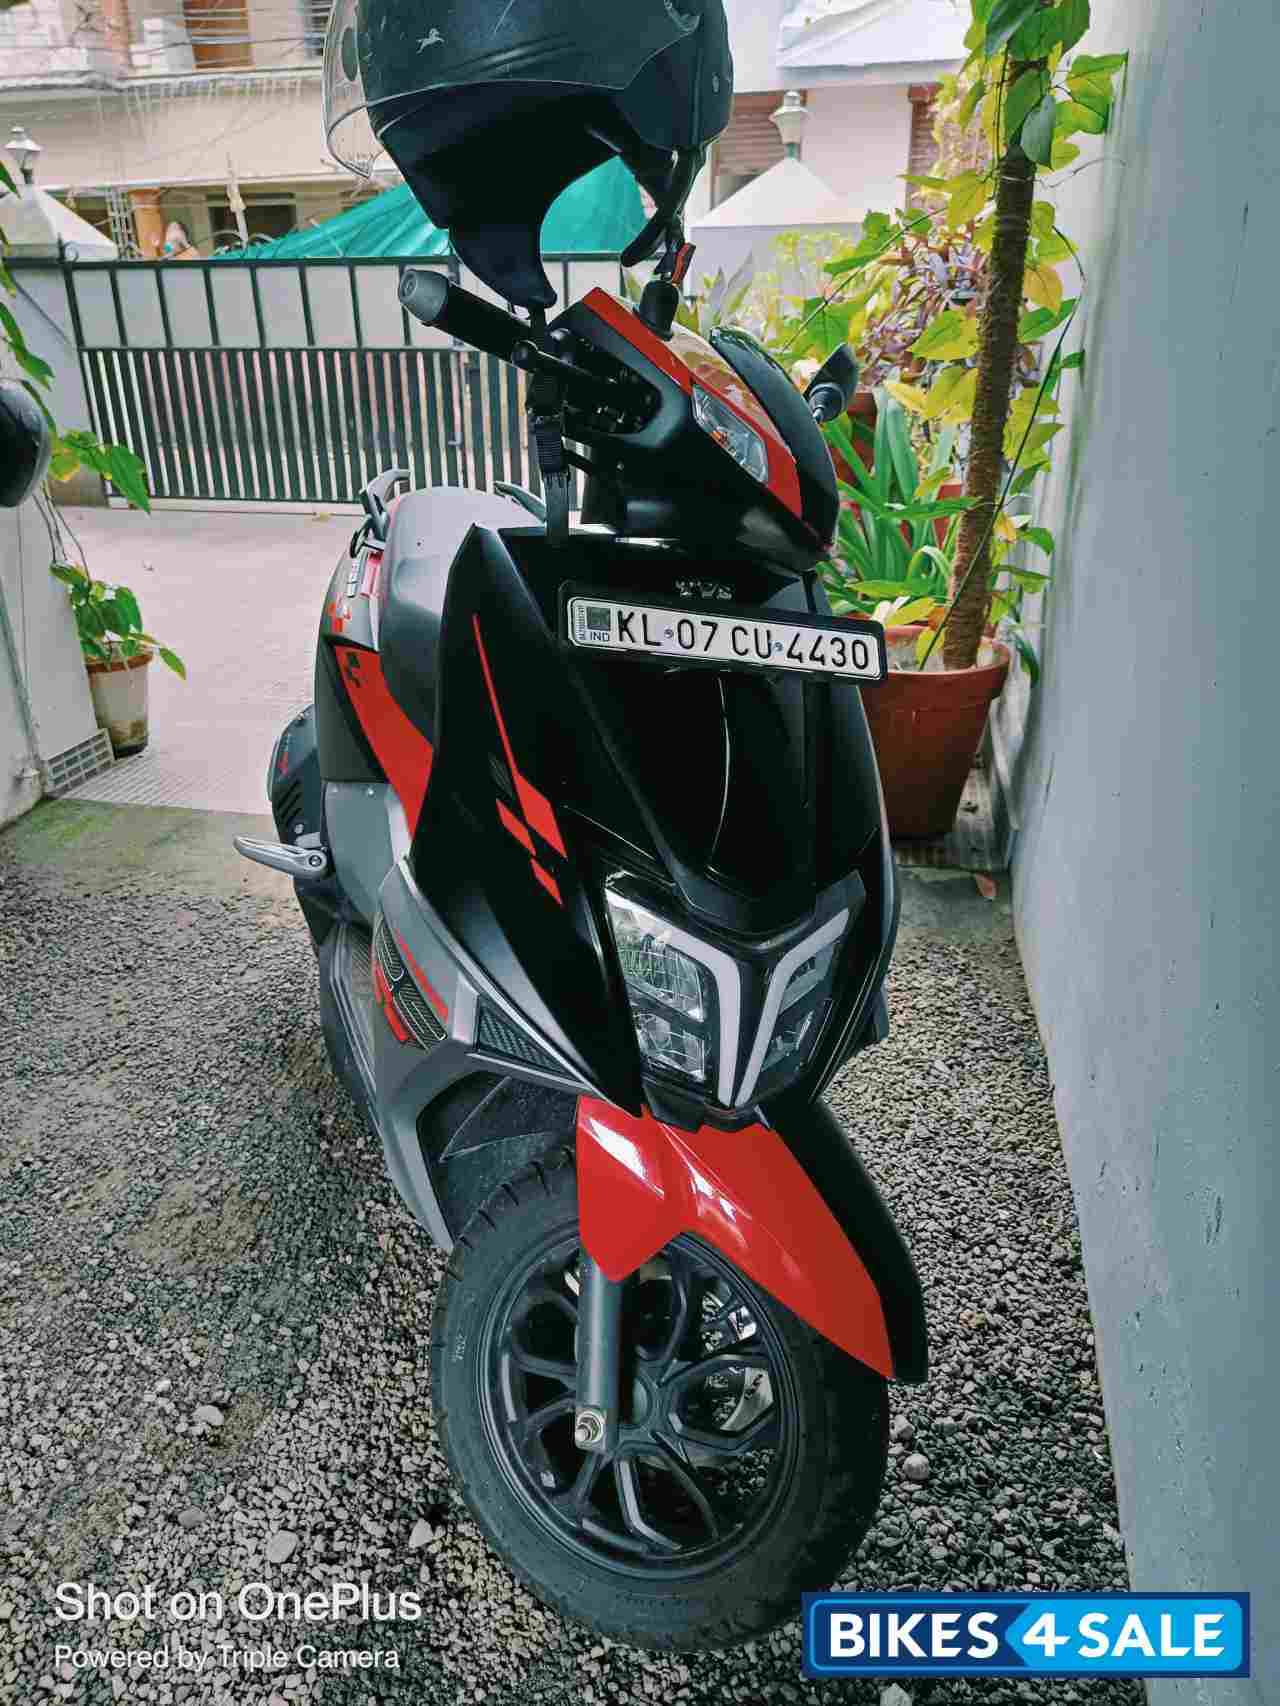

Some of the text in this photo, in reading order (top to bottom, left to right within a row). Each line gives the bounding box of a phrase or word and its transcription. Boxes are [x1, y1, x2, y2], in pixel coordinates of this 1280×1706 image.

[590, 631, 609, 641] IND
[616, 610, 661, 647] KL
[677, 619, 719, 652] 07
[731, 626, 772, 659] CU
[786, 632, 870, 670] 4430
